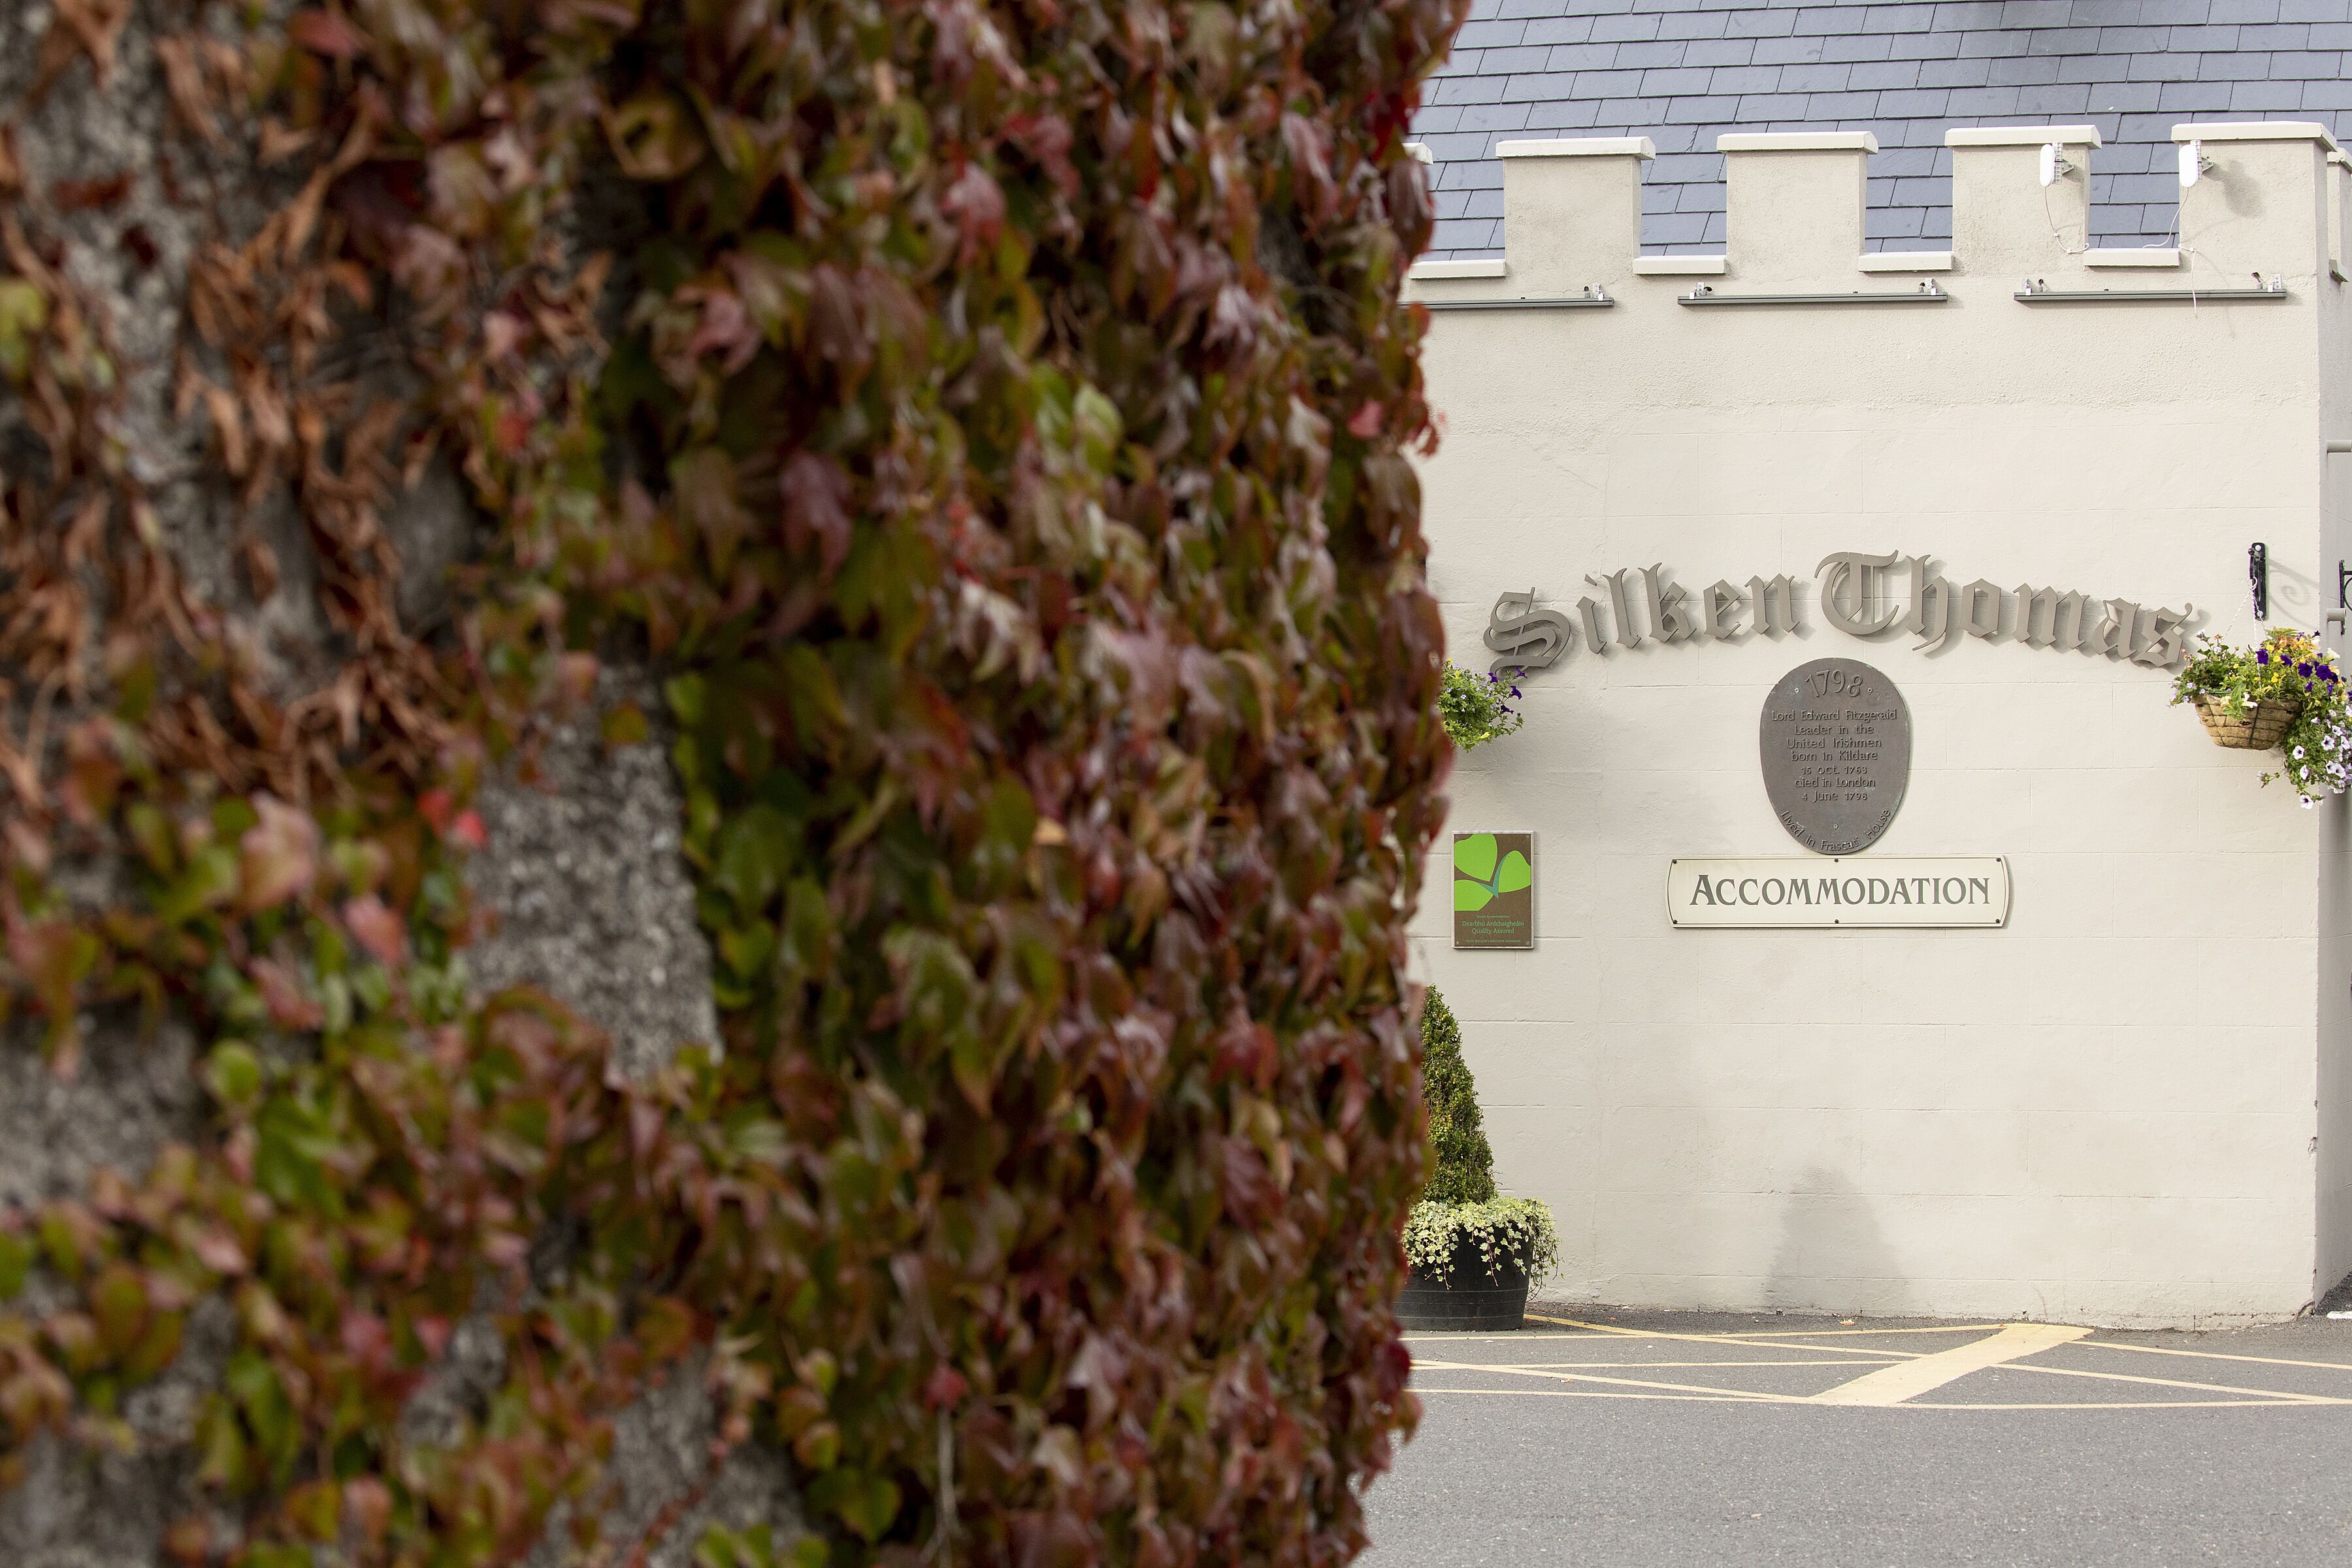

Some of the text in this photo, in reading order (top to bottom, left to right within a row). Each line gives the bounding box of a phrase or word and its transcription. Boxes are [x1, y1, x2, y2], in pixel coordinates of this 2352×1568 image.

[1483, 549, 2193, 681] Silken Thomas
[1805, 669, 1863, 698] 1798
[1772, 710, 1795, 721] Lord
[1801, 709, 1840, 721] Edward
[1794, 723, 1874, 735] Leader in the
[1786, 736, 1882, 749] United Irishmen
[1791, 749, 1878, 761] born in Kildare
[1801, 766, 1812, 775] 15
[1844, 766, 1868, 775] 1763
[1795, 776, 1876, 788] died in London
[1801, 791, 1868, 803] 4 June 1798
[1780, 809, 1805, 838] Lived
[1805, 834, 1816, 847] in
[1867, 808, 1891, 840] House
[1689, 874, 1991, 906] ACCOMMODATION
